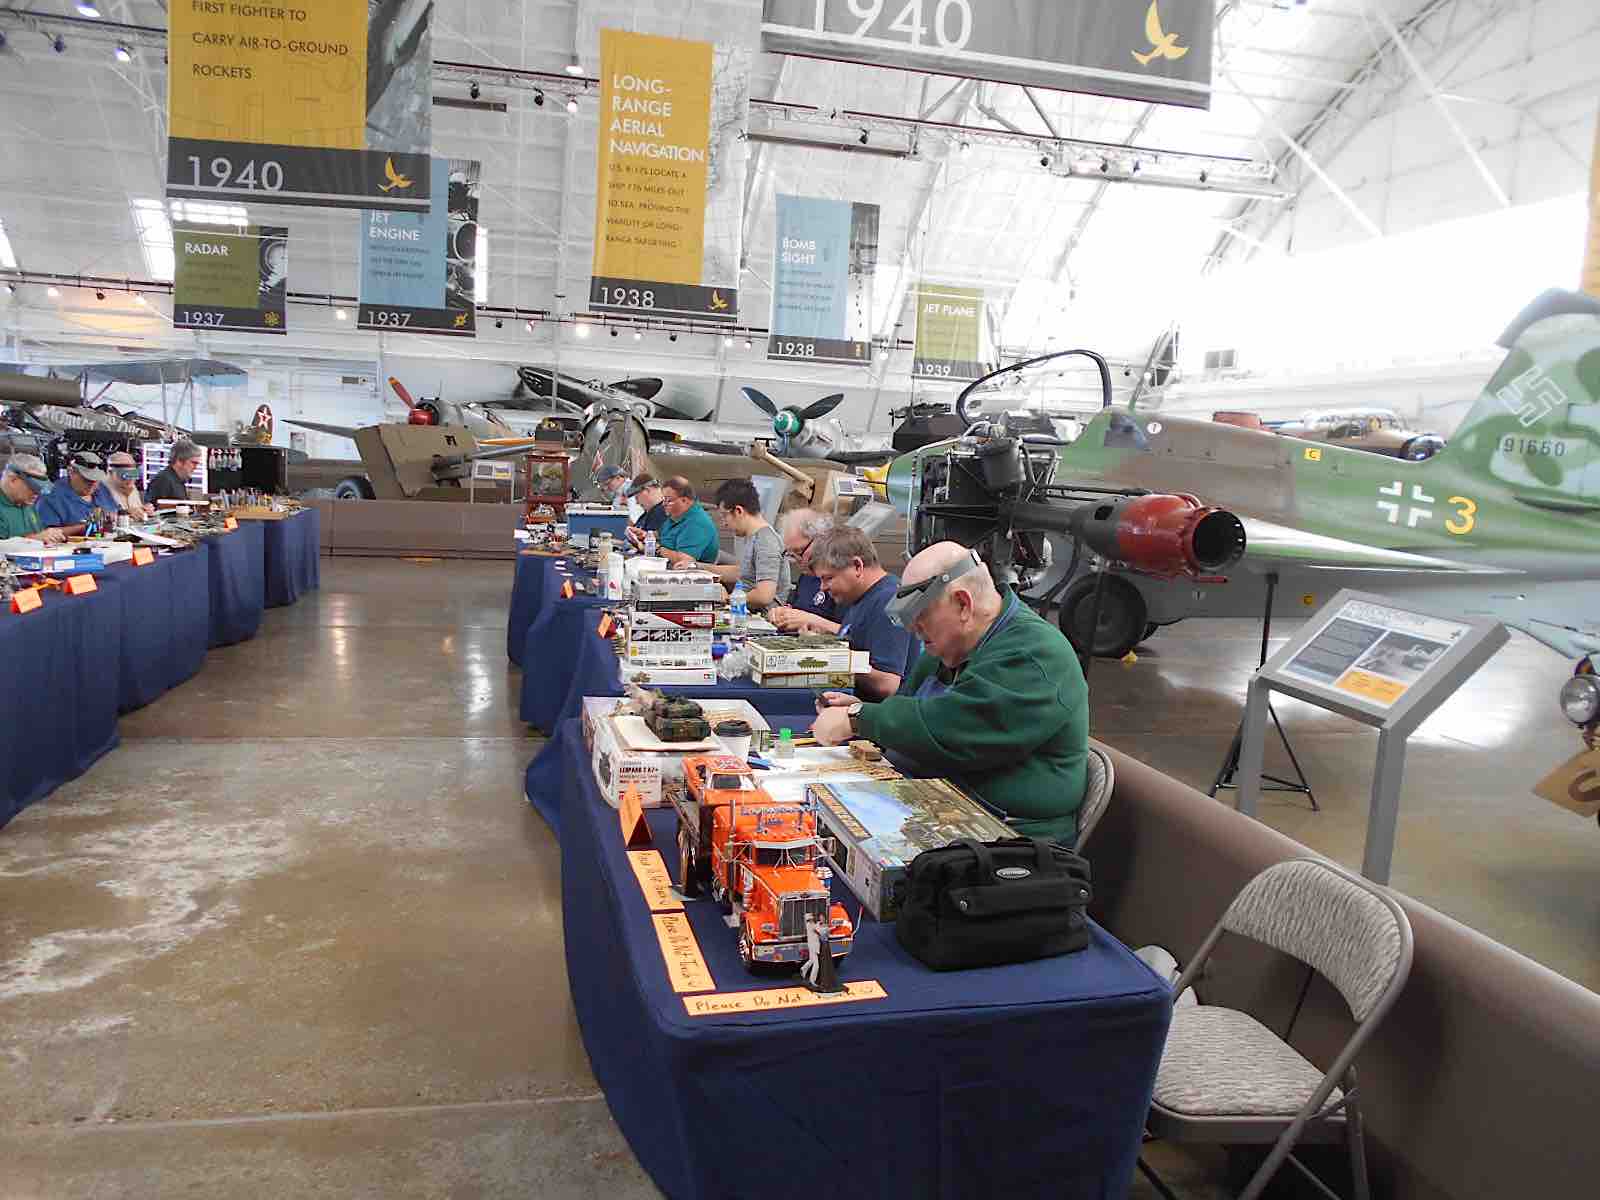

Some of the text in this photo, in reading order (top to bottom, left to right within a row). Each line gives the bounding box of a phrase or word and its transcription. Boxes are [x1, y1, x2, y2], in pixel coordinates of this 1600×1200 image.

[192, 1, 307, 21] FIRST FIGHTER TO
[812, 0, 972, 54] 1940
[192, 32, 349, 56] CARRY AIR-TO-GROUND
[192, 64, 252, 80] ROCKETS
[613, 73, 672, 95] LONG-
[612, 95, 673, 118] RANGE
[609, 118, 665, 138] AERIAL
[609, 138, 705, 162] NAVIGATION
[188, 155, 285, 192] 1940
[371, 209, 391, 224] JET
[368, 226, 421, 241] ENGINE
[184, 242, 229, 257] RADAR
[781, 237, 816, 250] BOMB
[781, 252, 816, 265] SIGHT
[600, 286, 656, 309] 1938
[183, 311, 225, 326] 1937
[367, 310, 412, 328] 1937
[923, 303, 976, 317] JET PLANE
[776, 341, 816, 357] 1938
[918, 363, 952, 377] 1939
[1445, 495, 1478, 535] 3
[695, 992, 801, 1012] Please Do Not
